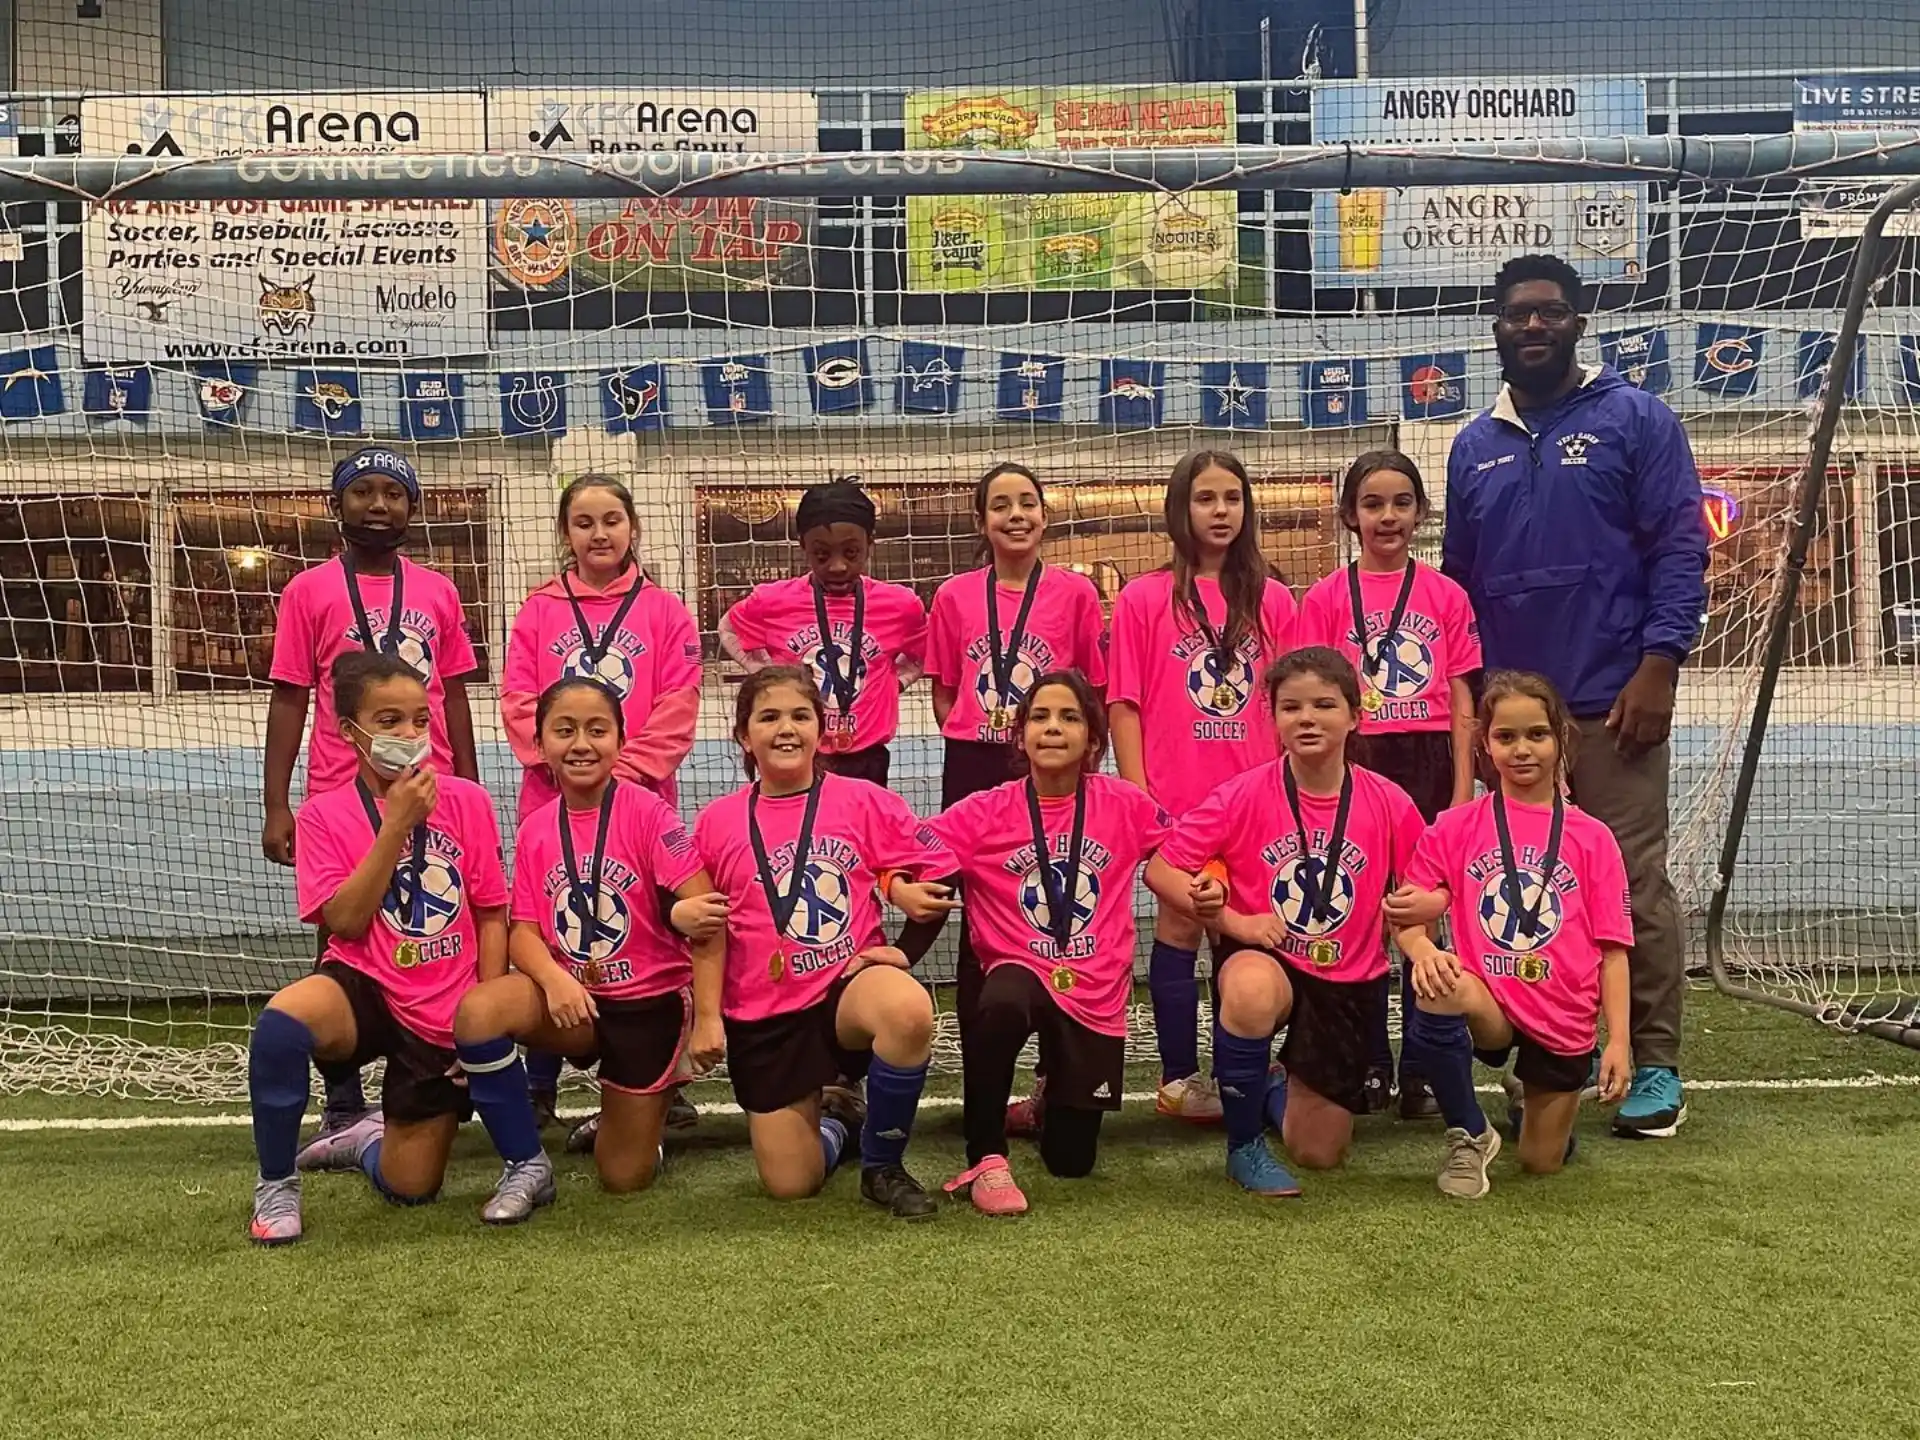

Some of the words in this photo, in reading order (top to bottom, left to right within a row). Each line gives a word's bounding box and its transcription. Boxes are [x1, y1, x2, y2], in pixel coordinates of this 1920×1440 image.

[1383, 88, 1462, 119] ANGRY
[1466, 87, 1576, 118] ORCHARD
[1801, 86, 1852, 105] LIVE
[1859, 86, 1920, 104] STRE
[266, 104, 420, 144] Arena
[637, 101, 758, 133] Arena
[1054, 101, 1133, 131] SIERRA
[1138, 100, 1228, 130] NEVADA
[842, 150, 964, 175] CLUB
[146, 198, 200, 214] AND
[1422, 194, 1536, 220] ANGRY
[1585, 204, 1625, 228] CFC
[107, 222, 201, 243] Soccer,
[585, 220, 678, 262] ON
[688, 220, 802, 262] TAP
[1402, 223, 1554, 251] ORCHARD
[107, 248, 201, 269] Parties
[209, 246, 263, 268] and
[271, 245, 366, 273] Special
[372, 245, 457, 265] Events
[375, 284, 457, 314] Modelo
[163, 338, 408, 358] www.cfcarena.com
[415, 387, 447, 397] LIGHT
[344, 608, 386, 643] WST
[402, 608, 437, 640] AVEN
[548, 627, 583, 658] WES
[595, 623, 647, 658] HVEN
[786, 625, 820, 654] WES
[833, 622, 882, 660] HAEN
[1346, 611, 1386, 646] WST
[1392, 610, 1441, 643] AVEN
[1010, 629, 1055, 668] AVEN
[1171, 633, 1212, 660] WES
[1192, 721, 1247, 740] SOCCER
[425, 829, 464, 861] AVEN
[1004, 836, 1051, 875] WES
[1056, 833, 1113, 870] HVEN
[1312, 830, 1369, 875] HVEN
[543, 862, 569, 898] WES
[579, 855, 639, 892] HVEN
[754, 841, 797, 883] EST
[1466, 848, 1503, 883] WES
[1521, 846, 1579, 894] HAEN
[418, 933, 464, 964] CCER
[791, 934, 856, 975] SOCCER
[1483, 953, 1552, 979] SOCCR
